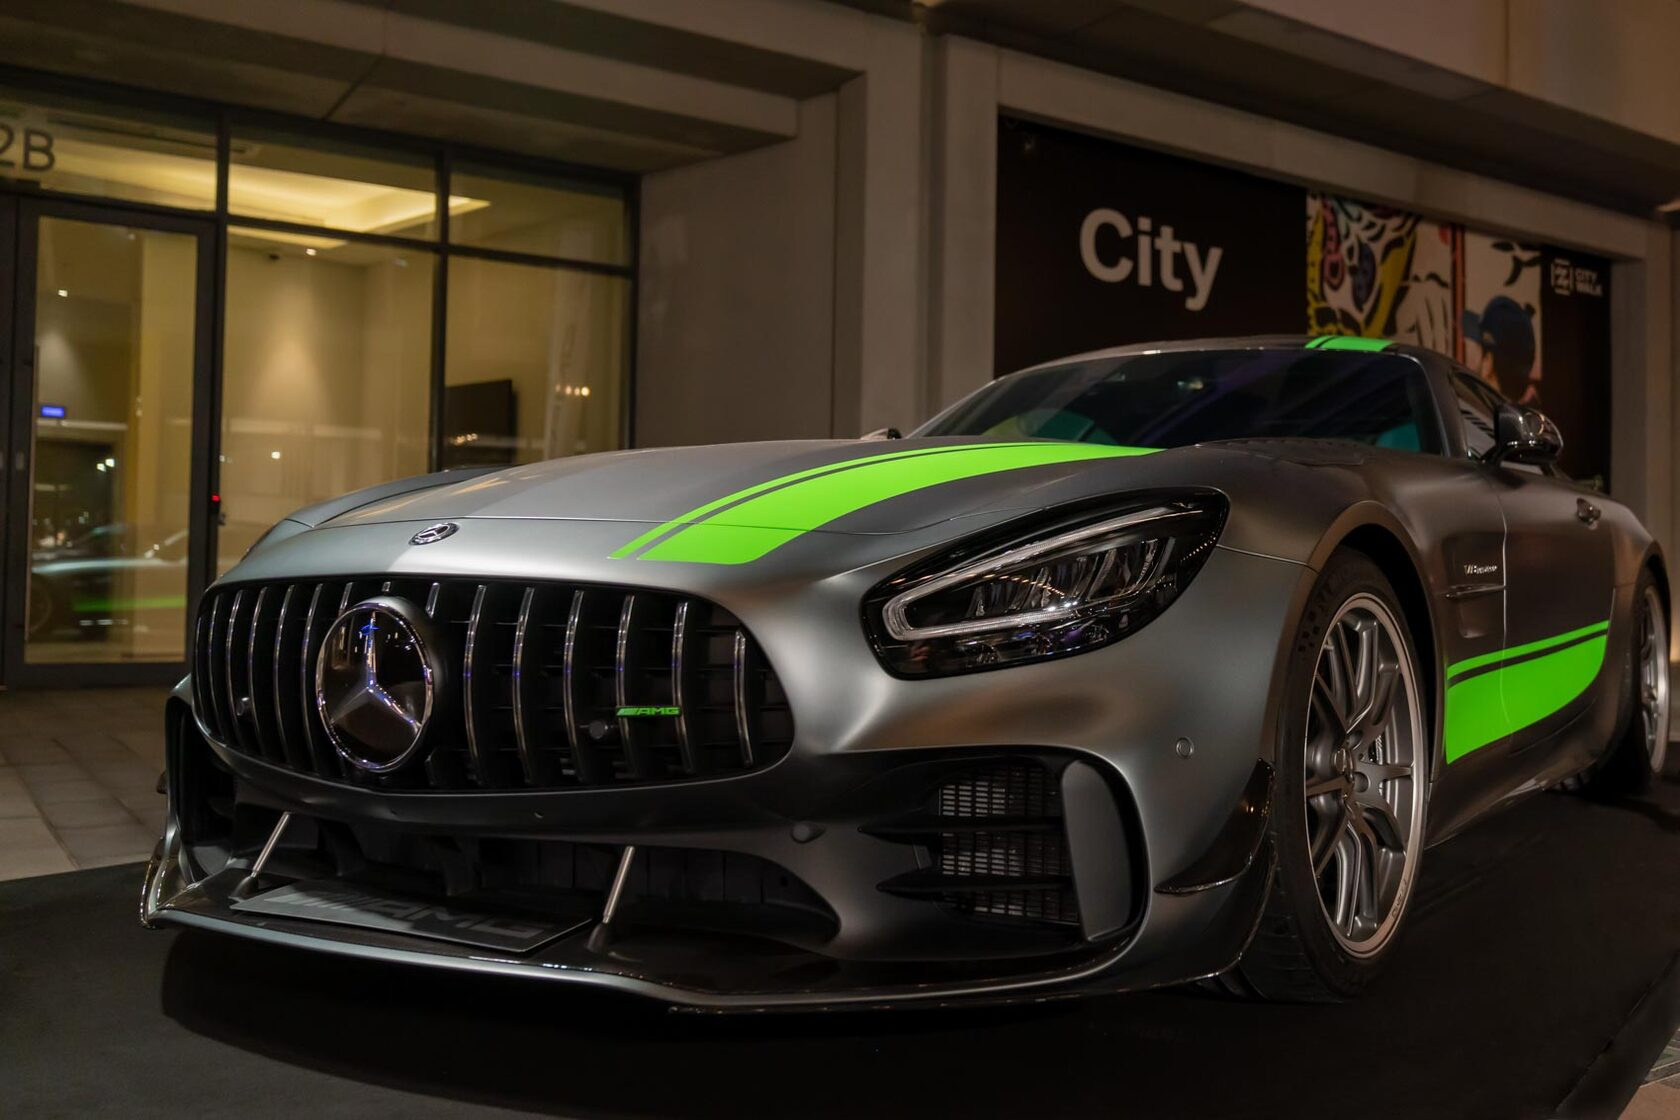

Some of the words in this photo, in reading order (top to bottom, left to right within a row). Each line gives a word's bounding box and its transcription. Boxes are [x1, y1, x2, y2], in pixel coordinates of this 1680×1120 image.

[1080, 207, 1223, 311] City
[1575, 267, 1598, 283] CITY
[637, 706, 680, 716] AMG
[363, 897, 554, 938] AMG
